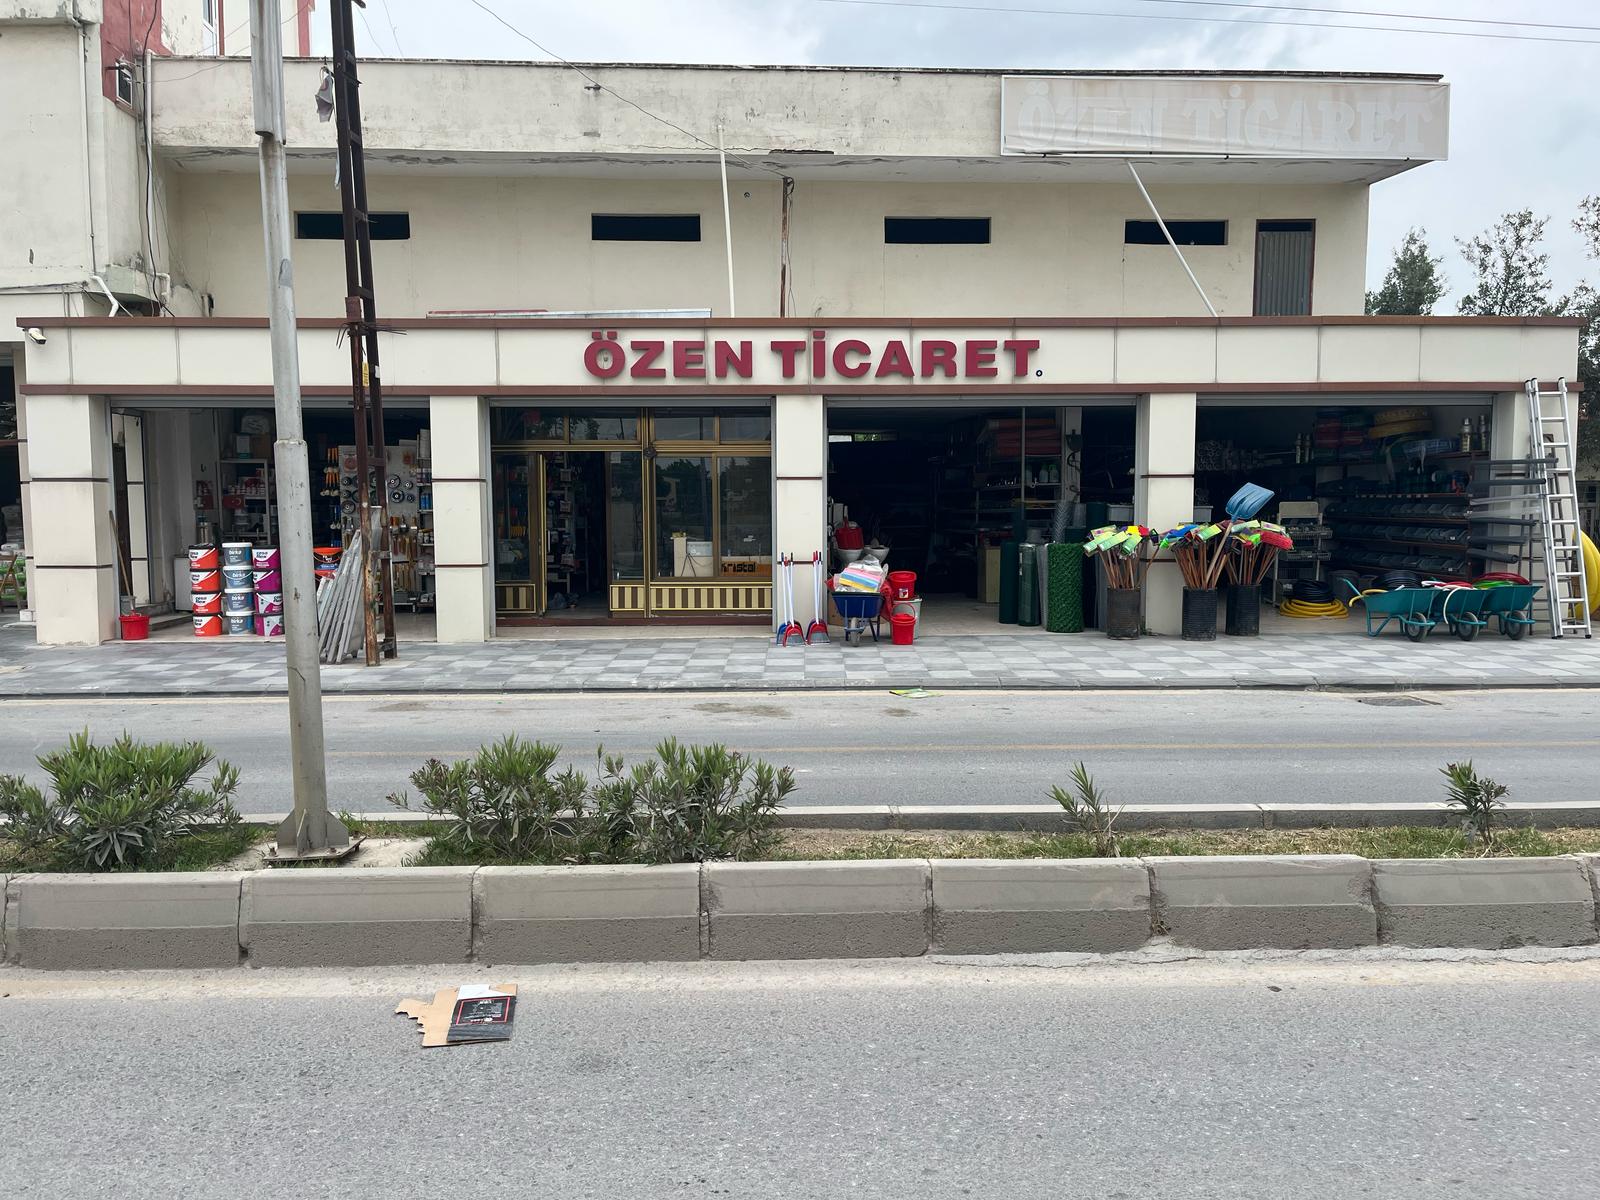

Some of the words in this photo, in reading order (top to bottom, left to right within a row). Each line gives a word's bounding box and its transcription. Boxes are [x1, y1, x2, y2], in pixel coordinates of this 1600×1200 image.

[1183, 84, 1433, 153] TİCARET
[584, 331, 753, 378] ÖZEN
[771, 331, 1040, 378] TİCARET
